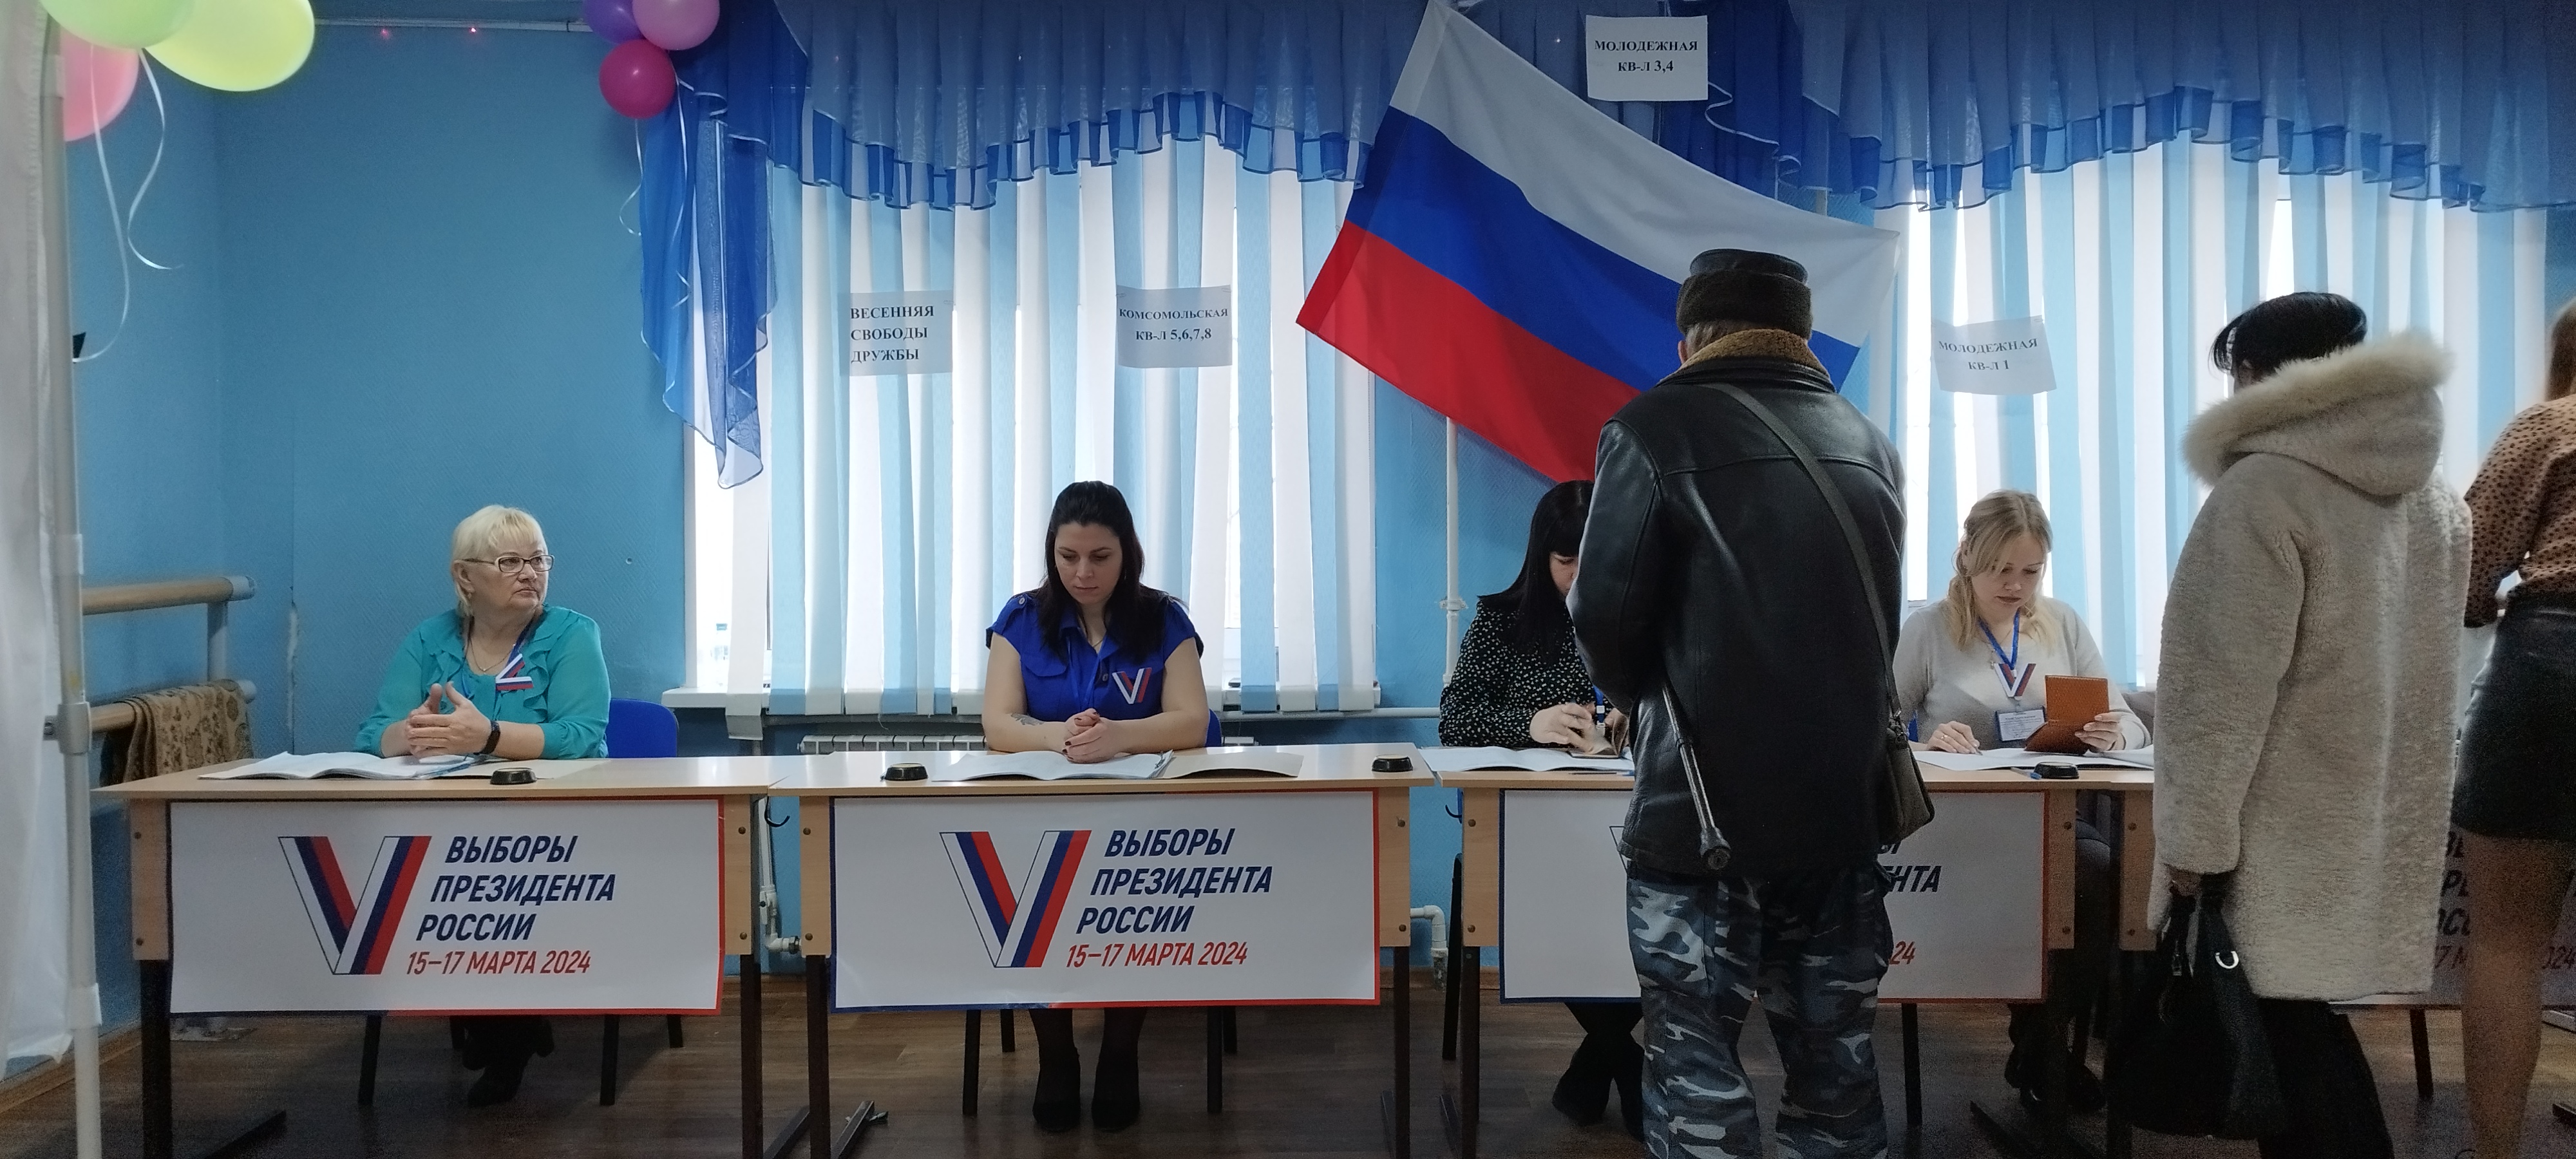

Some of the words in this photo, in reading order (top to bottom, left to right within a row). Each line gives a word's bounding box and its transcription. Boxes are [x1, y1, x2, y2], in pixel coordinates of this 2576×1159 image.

[1594, 40, 1698, 53] МОЛОДЕЖНАЯ
[1618, 61, 1650, 72] КВ-Л
[1654, 60, 1674, 73] 3,4
[850, 305, 934, 319] ВЕСЕННЯЯ
[1119, 307, 1229, 321] КОМСОМОЛЬСКАЯ
[850, 326, 928, 341] СВОБОДЫ
[1135, 330, 1167, 341] КВ-Л
[1170, 327, 1213, 342] 5,6,7,8
[1938, 337, 2038, 354] МОЛОДЕЖНАЯ
[850, 348, 920, 364] ДРУЖБЫ
[1968, 361, 2000, 371] КВ-Л
[2003, 359, 2010, 370] 1
[444, 835, 579, 864] ВЫБОРЫ
[1104, 827, 1236, 858] ВЫБОРЫ
[430, 873, 616, 905] ПРЕЗИДЕНТА
[1090, 866, 1273, 899] ПРЕЗИДЕНТА
[415, 913, 535, 942] РОССИИ
[1075, 905, 1196, 935] РОССИИ
[468, 950, 536, 975] МАРТА
[540, 950, 592, 975] 2024
[1124, 942, 1195, 967] МАРТА
[1197, 941, 1248, 966] 2024
[1888, 941, 1916, 965] 24
